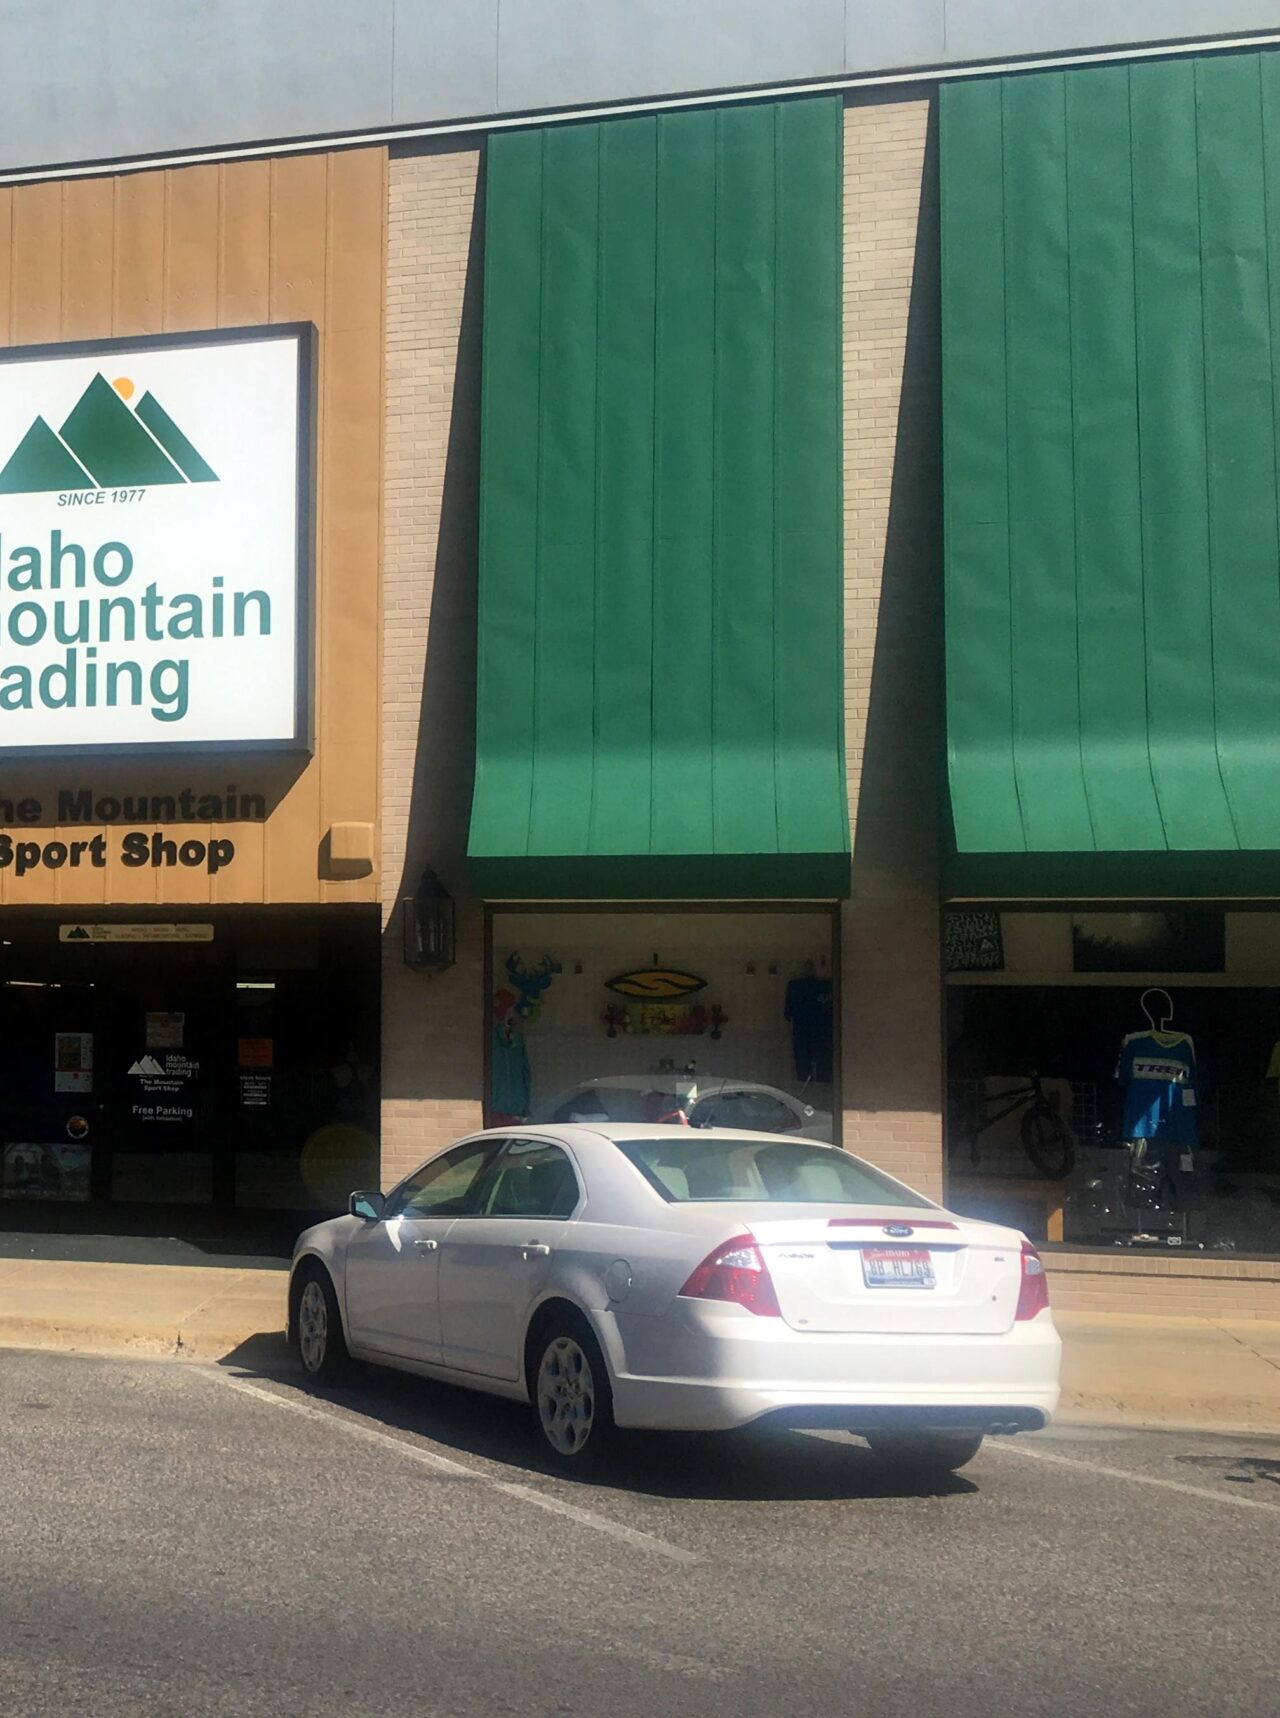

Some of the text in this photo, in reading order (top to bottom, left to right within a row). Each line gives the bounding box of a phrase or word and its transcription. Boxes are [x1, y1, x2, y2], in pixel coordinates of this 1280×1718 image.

[57, 489, 146, 507] SINCE 1977
[57, 784, 266, 823] Mountain
[120, 831, 235, 875] Shop
[165, 1053, 187, 1062] Idaho
[131, 1104, 193, 1118] Free Parking
